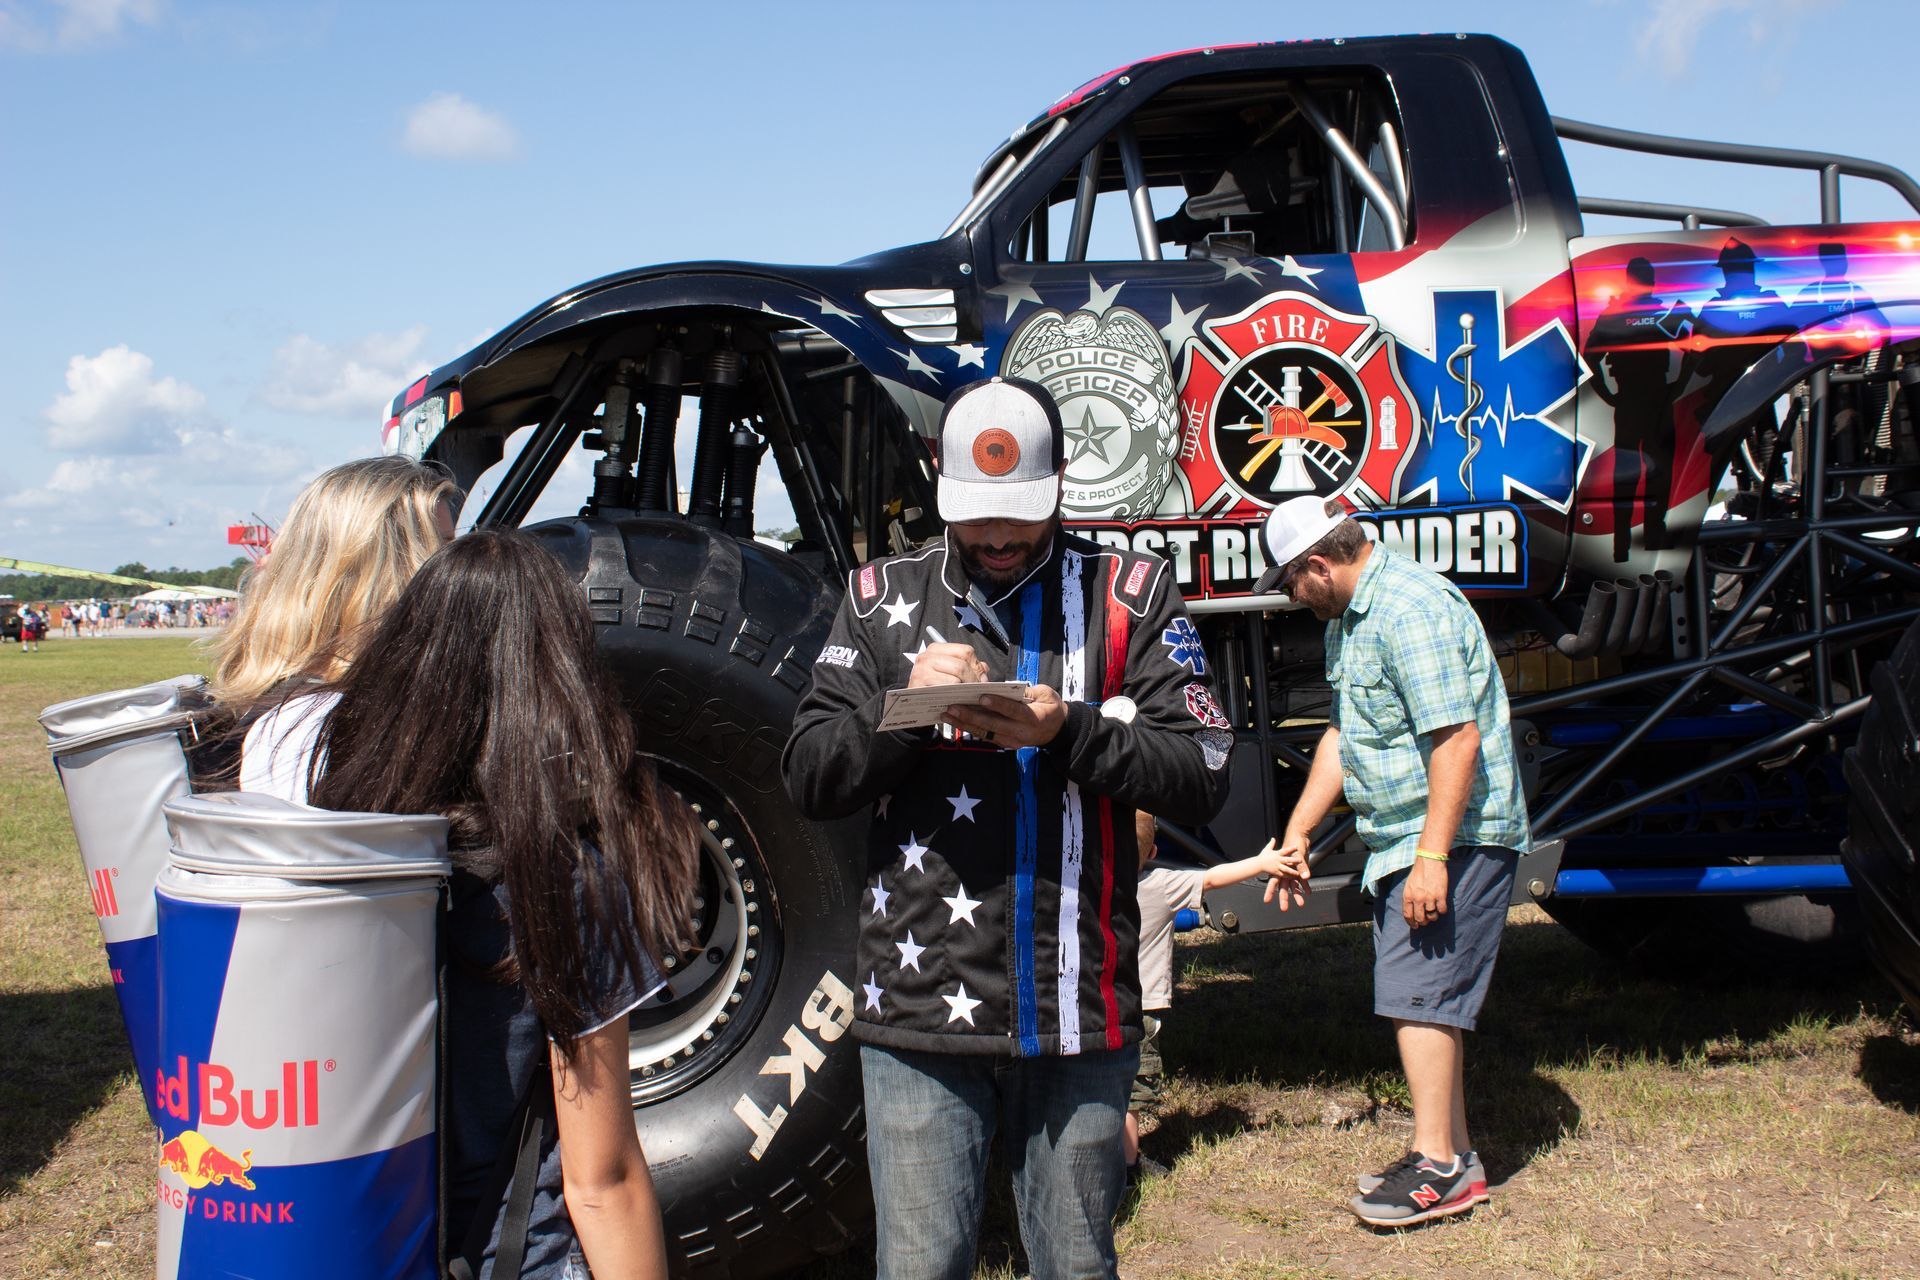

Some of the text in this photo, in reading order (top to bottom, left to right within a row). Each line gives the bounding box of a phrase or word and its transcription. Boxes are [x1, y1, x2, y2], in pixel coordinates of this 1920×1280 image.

[1250, 314, 1330, 345] FIRE
[1625, 317, 1656, 326] POLICE
[1738, 311, 1757, 320] FIRE
[1036, 351, 1138, 376] POLICE
[1047, 375, 1148, 408] FFICER
[1089, 472, 1144, 501] PROTECT
[1213, 510, 1517, 582] RNDER
[1126, 562, 1147, 593] SIMPSON
[733, 969, 855, 1162] BKT
[157, 1055, 190, 1122] ed
[157, 1179, 294, 1224] ERGY DRINK
